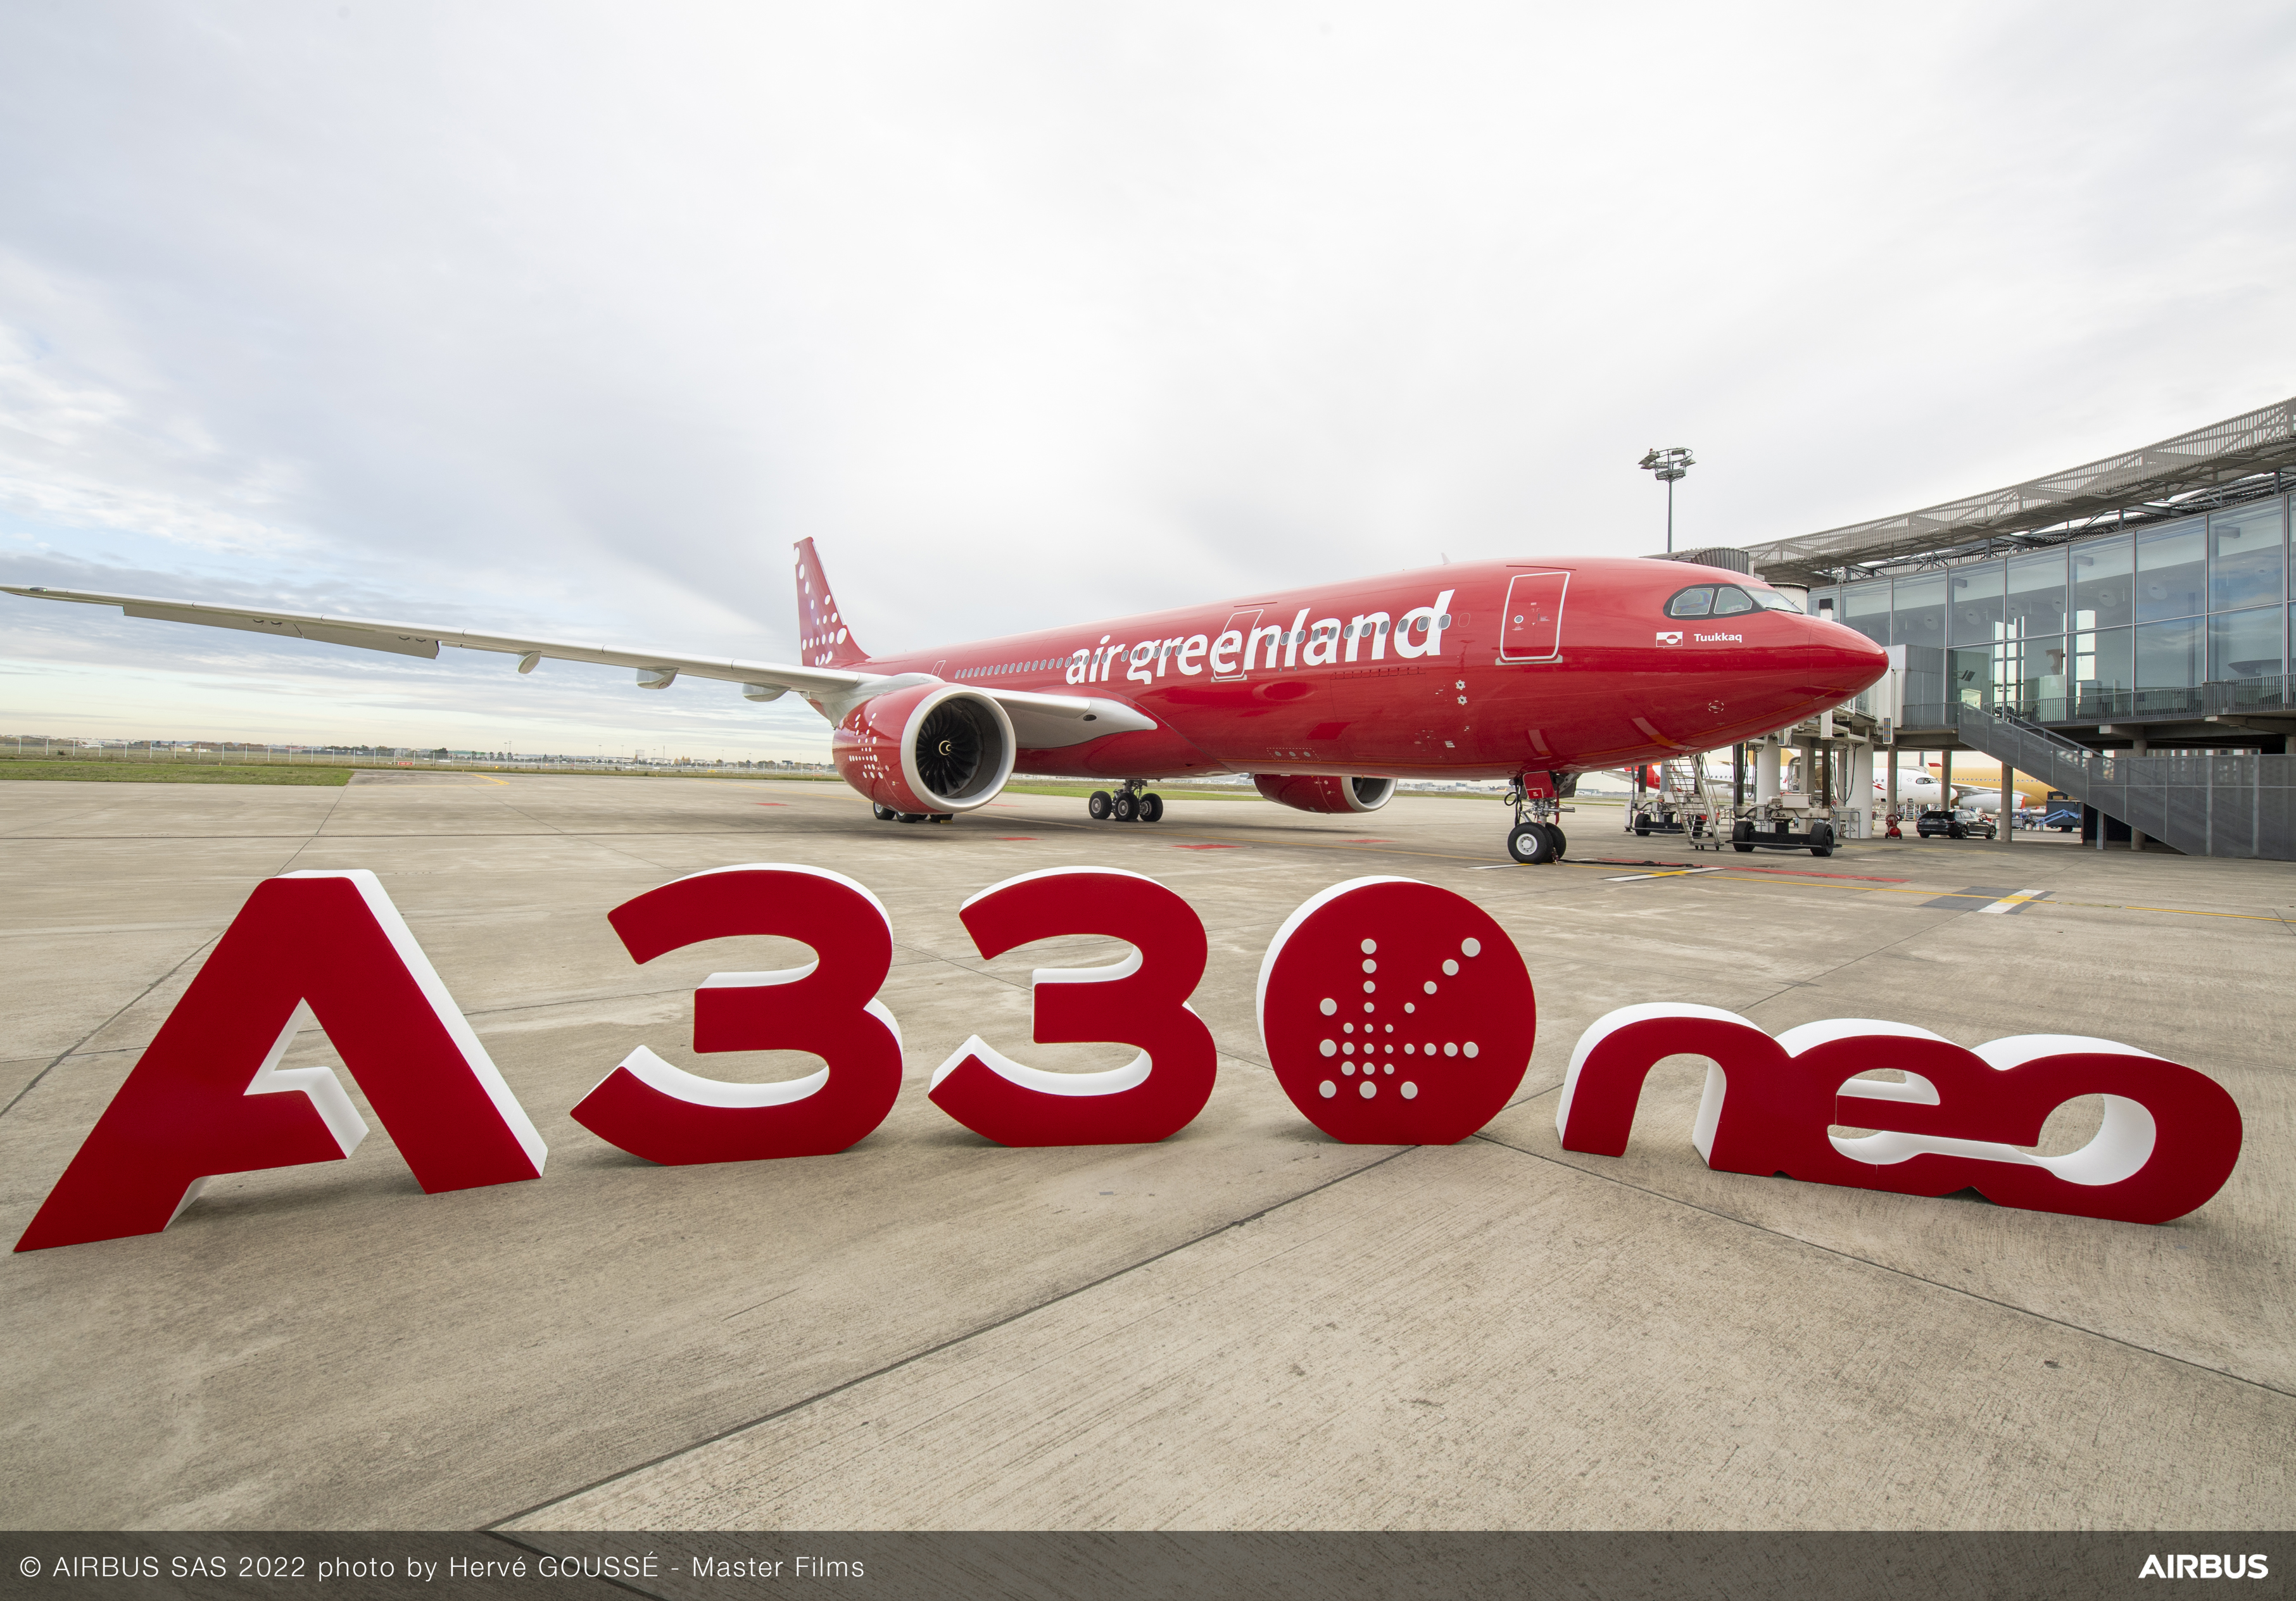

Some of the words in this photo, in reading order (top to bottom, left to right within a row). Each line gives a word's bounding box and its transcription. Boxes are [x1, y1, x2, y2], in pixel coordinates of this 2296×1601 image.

[1065, 634, 1125, 685] air
[1126, 589, 1455, 685] greenland
[1693, 632, 1743, 643] Tuukkaq
[1555, 1001, 2244, 1226] neo
